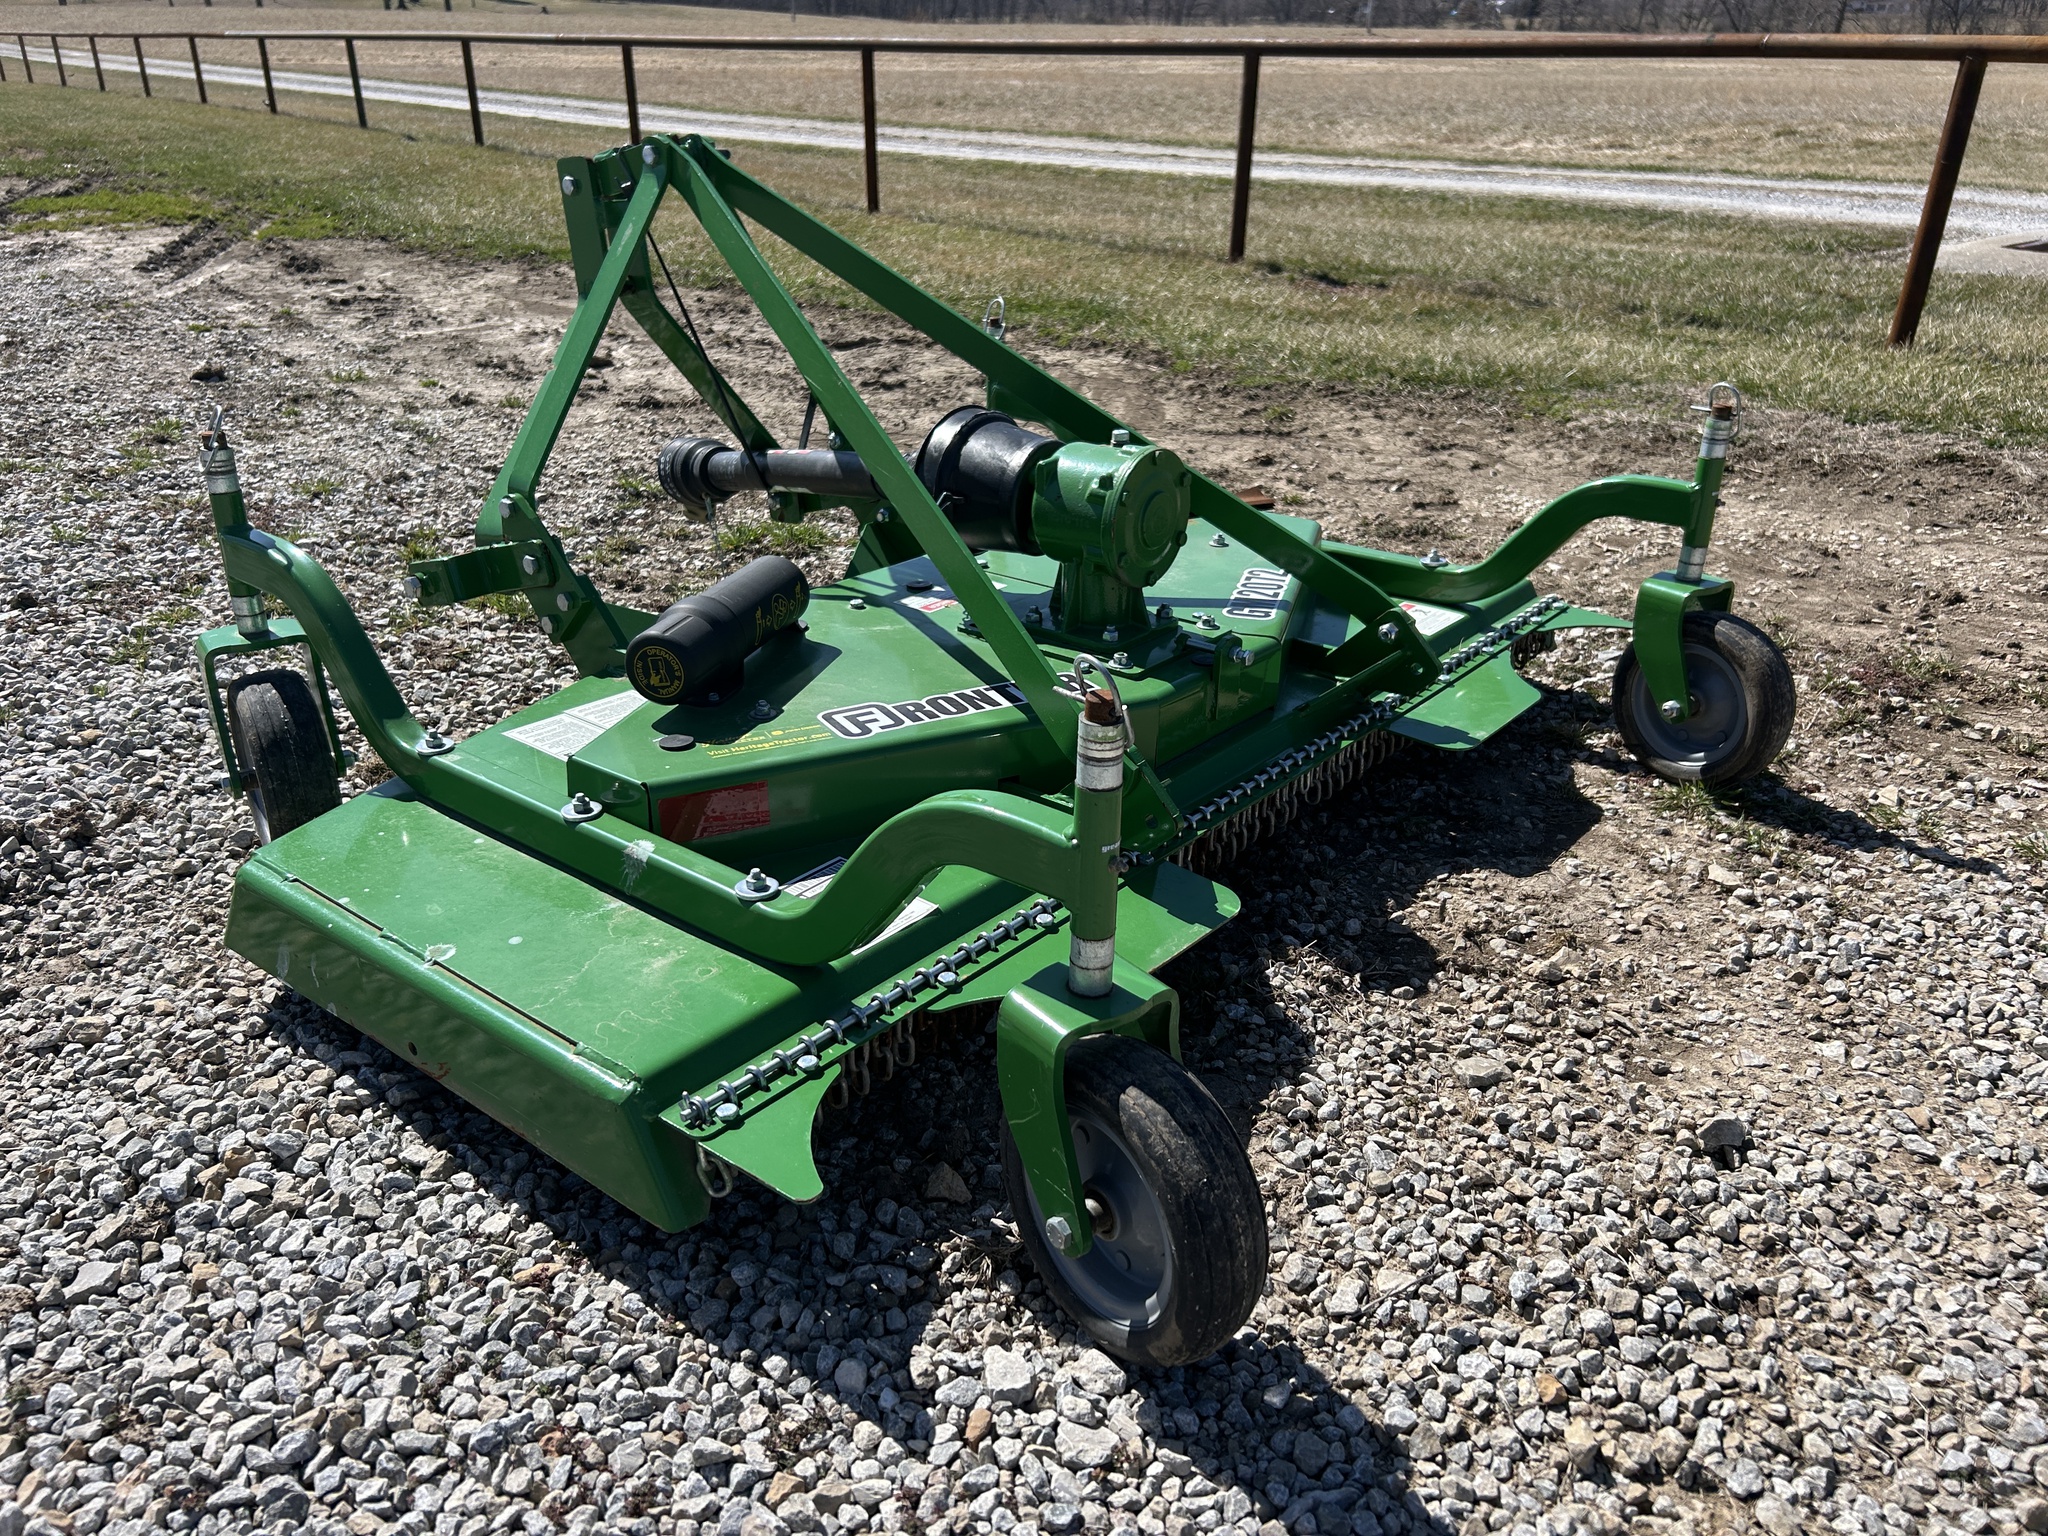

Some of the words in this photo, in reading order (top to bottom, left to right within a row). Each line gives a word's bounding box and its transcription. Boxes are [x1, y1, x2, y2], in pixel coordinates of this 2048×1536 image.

[636, 659, 649, 687] INSIDE
[706, 748, 729, 757] Visit
[730, 732, 832, 752] HeritageTractor.com
